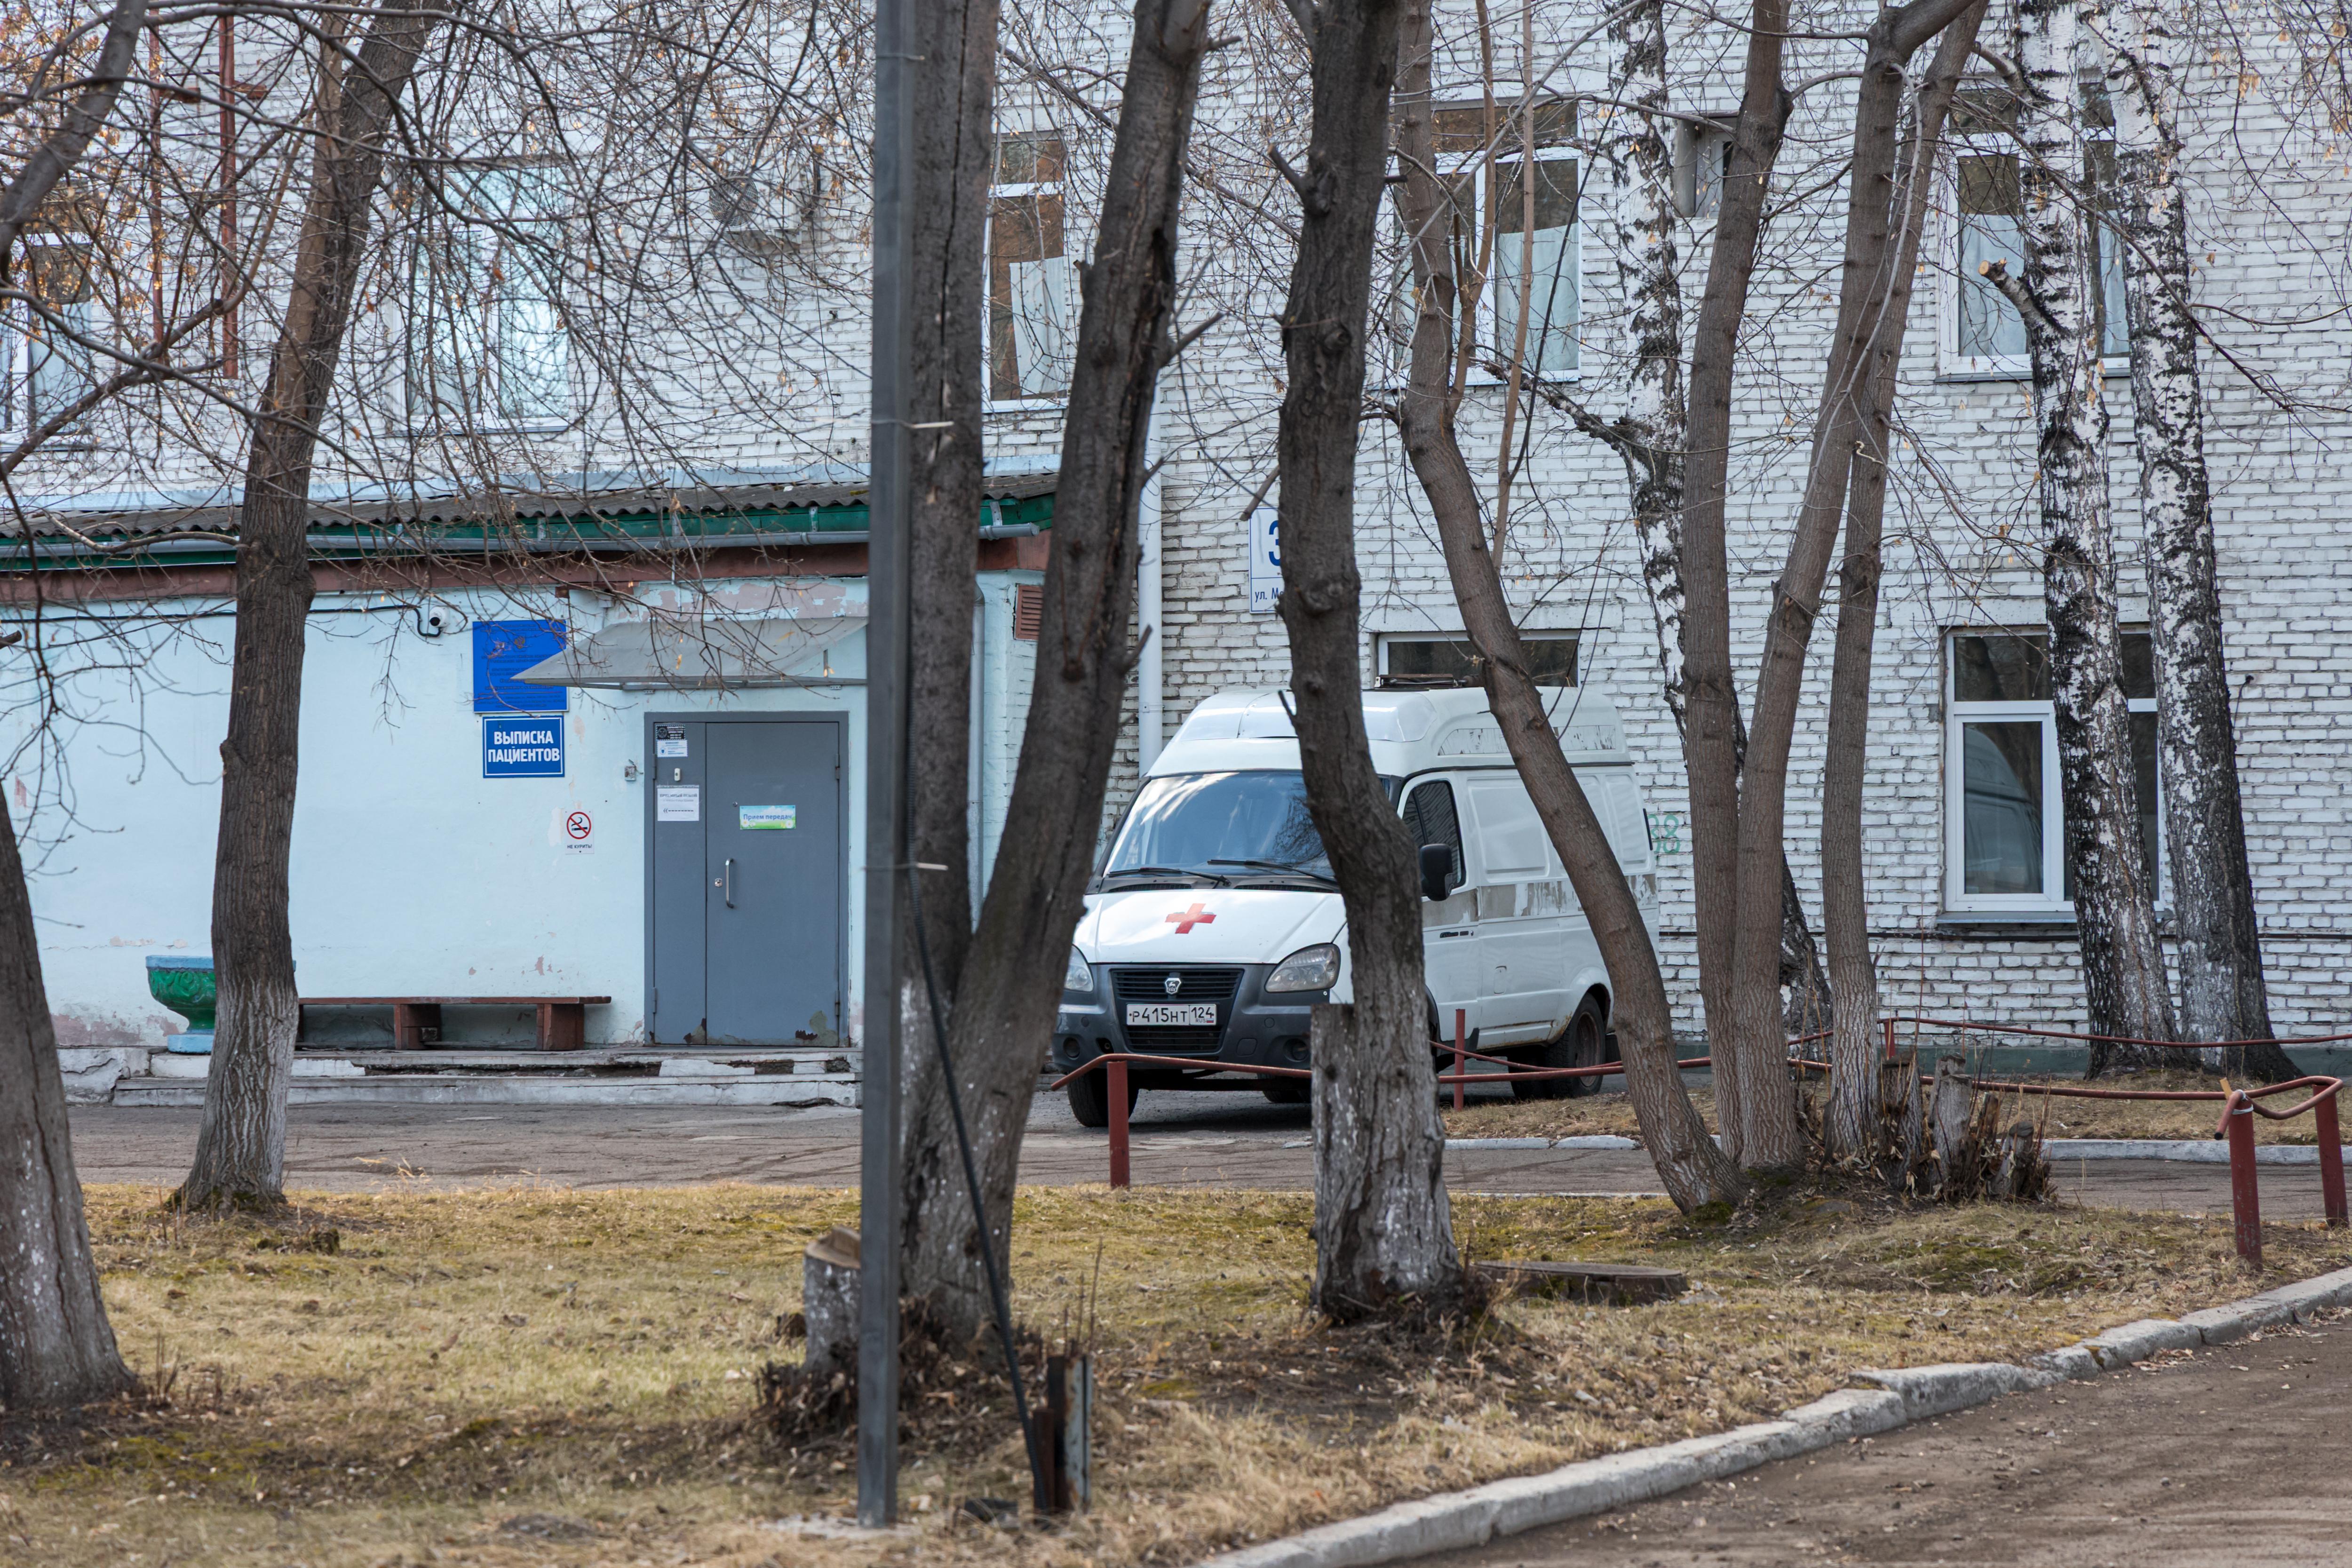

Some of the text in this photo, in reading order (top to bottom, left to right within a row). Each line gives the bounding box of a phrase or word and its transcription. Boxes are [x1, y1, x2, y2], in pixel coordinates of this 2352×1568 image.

[1255, 591, 1267, 603] ул.
[493, 731, 554, 745] ВЫПИСКА
[488, 748, 560, 764] ПАЦИЕНТОВ
[1191, 1007, 1213, 1019] 124
